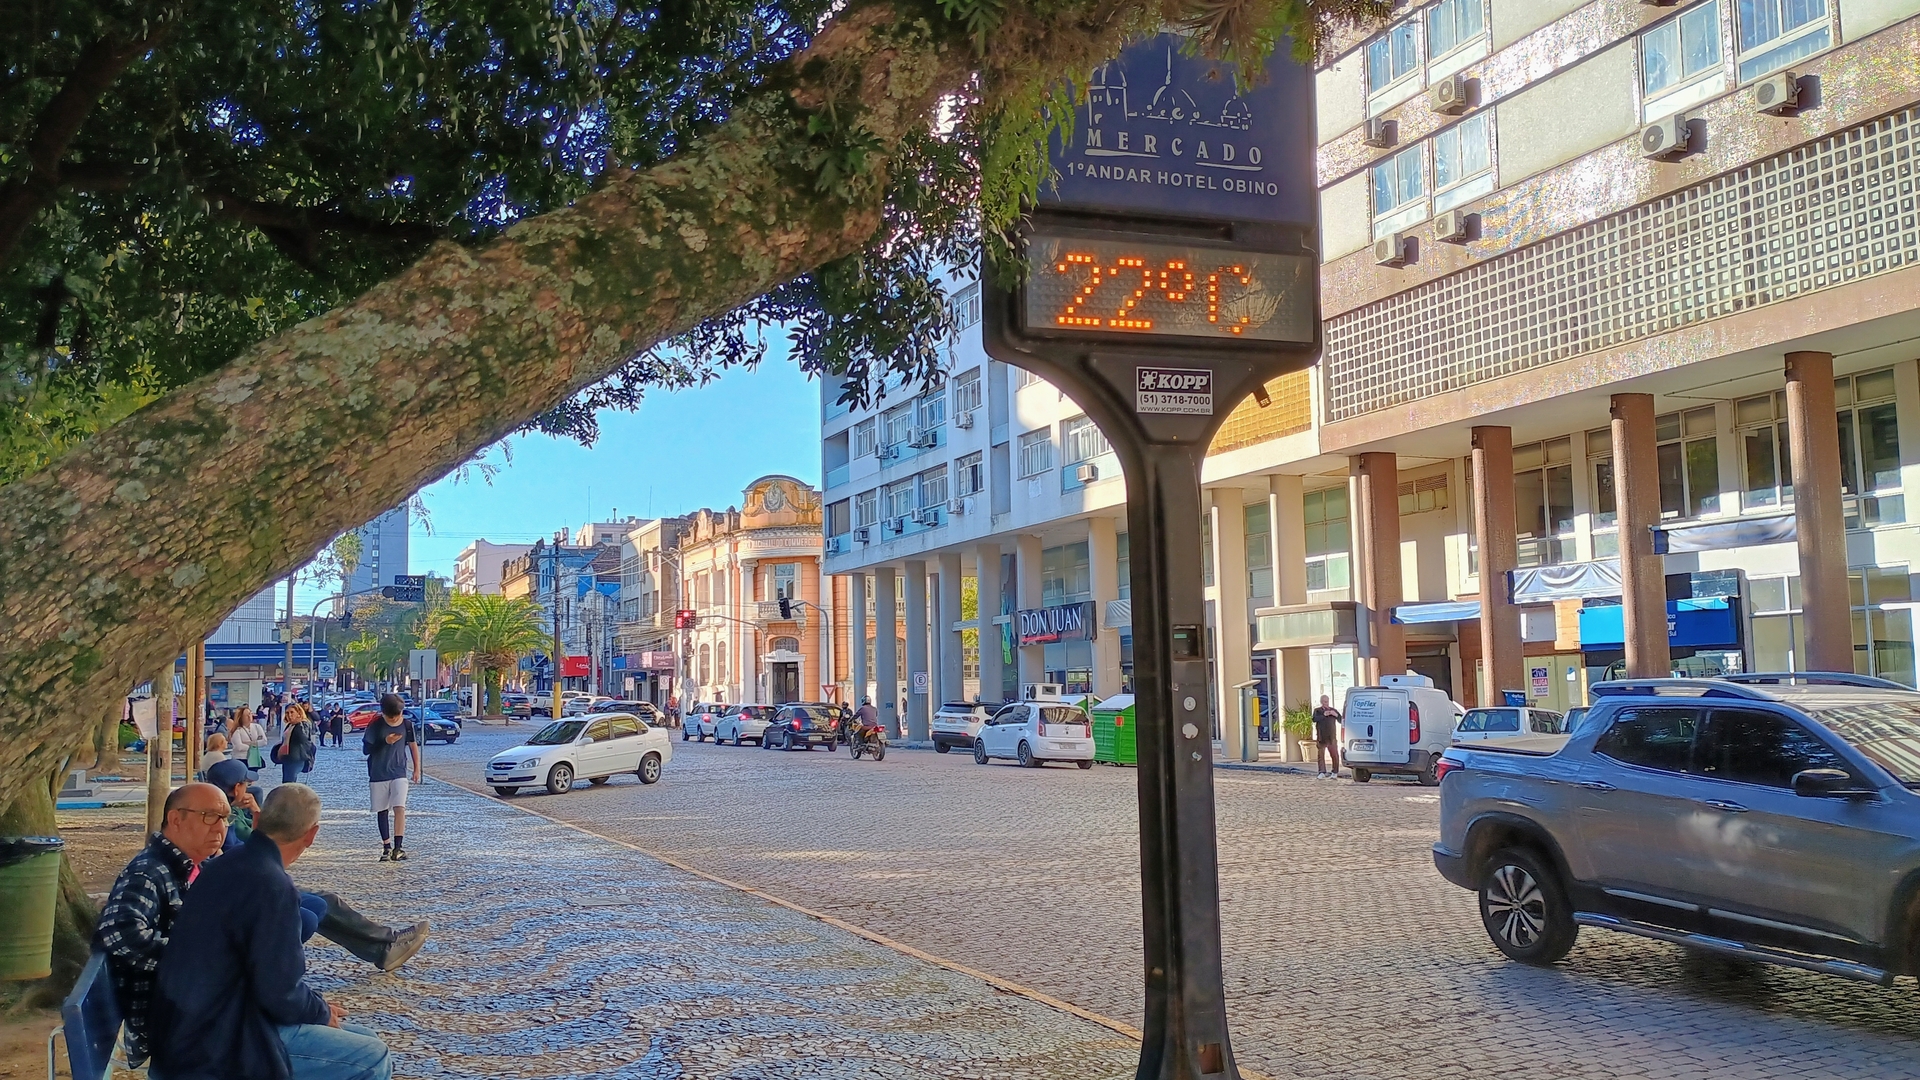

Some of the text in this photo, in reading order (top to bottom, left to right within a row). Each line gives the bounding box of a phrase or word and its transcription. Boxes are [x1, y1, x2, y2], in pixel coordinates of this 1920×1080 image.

[1086, 128, 1262, 165] MERCADO
[1157, 171, 1217, 190] HOTEL
[1222, 178, 1279, 196] OBINO
[1156, 374, 1208, 390] KOPP
[1140, 394, 1211, 405] (51) 3718-7000
[1021, 606, 1082, 636] DON JUAN
[1353, 700, 1377, 708] TopFlex
